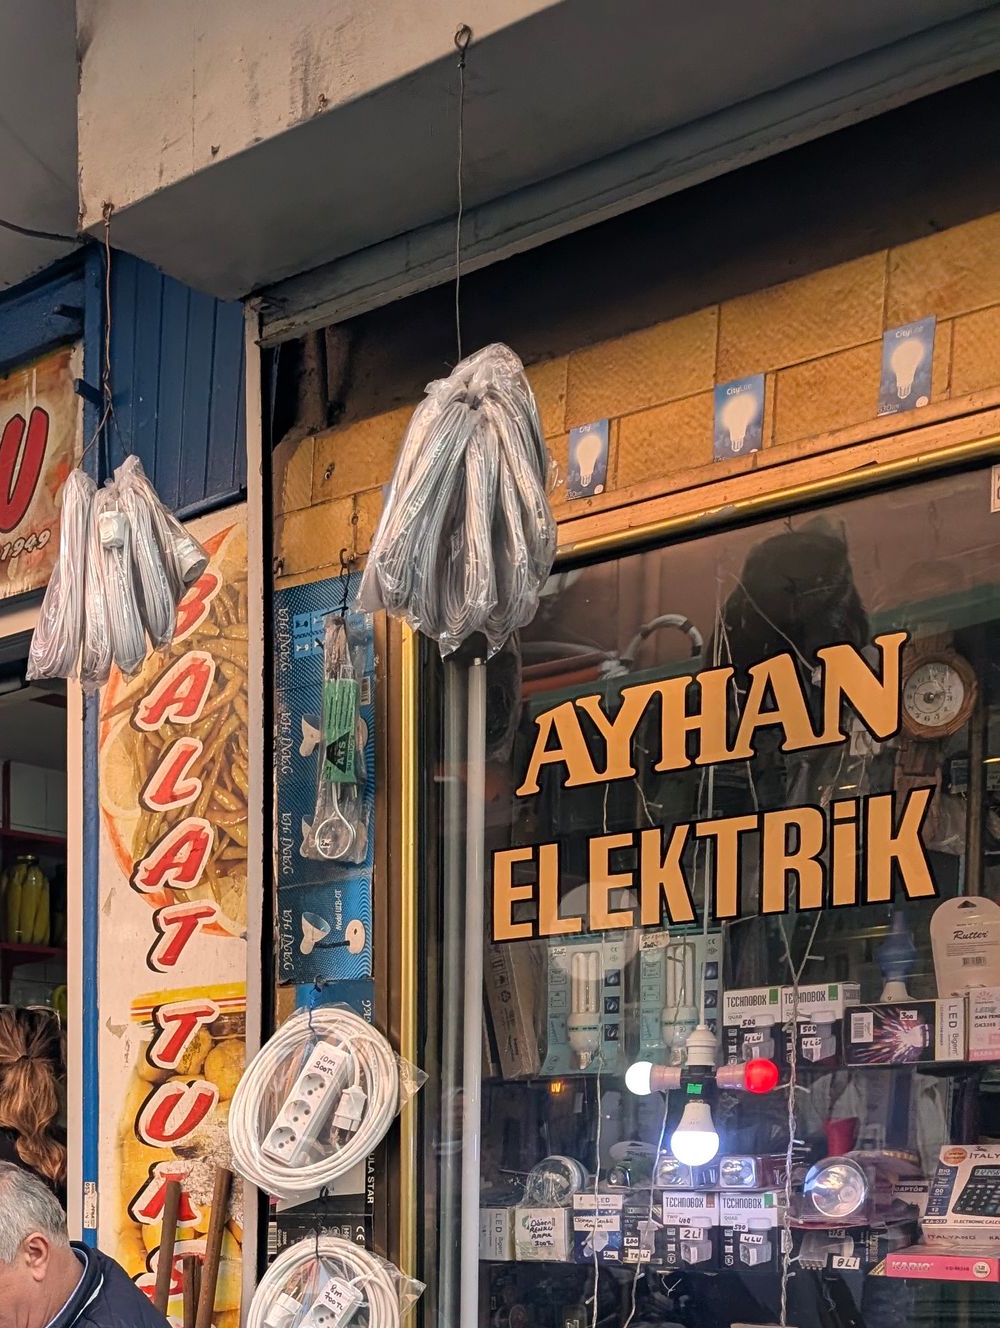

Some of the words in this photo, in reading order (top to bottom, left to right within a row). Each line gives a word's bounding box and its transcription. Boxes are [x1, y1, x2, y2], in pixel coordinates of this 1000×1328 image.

[516, 632, 908, 797] AYHAN
[953, 930, 989, 941] Rutter
[727, 995, 767, 1008] TECHNOBOX
[784, 991, 826, 1005] TEHNOBOX
[948, 1004, 958, 1029] LED
[366, 1176, 375, 1204] STAR
[665, 1196, 704, 1208] TECHNOBOX
[723, 1197, 762, 1209] TECHNOBOX
